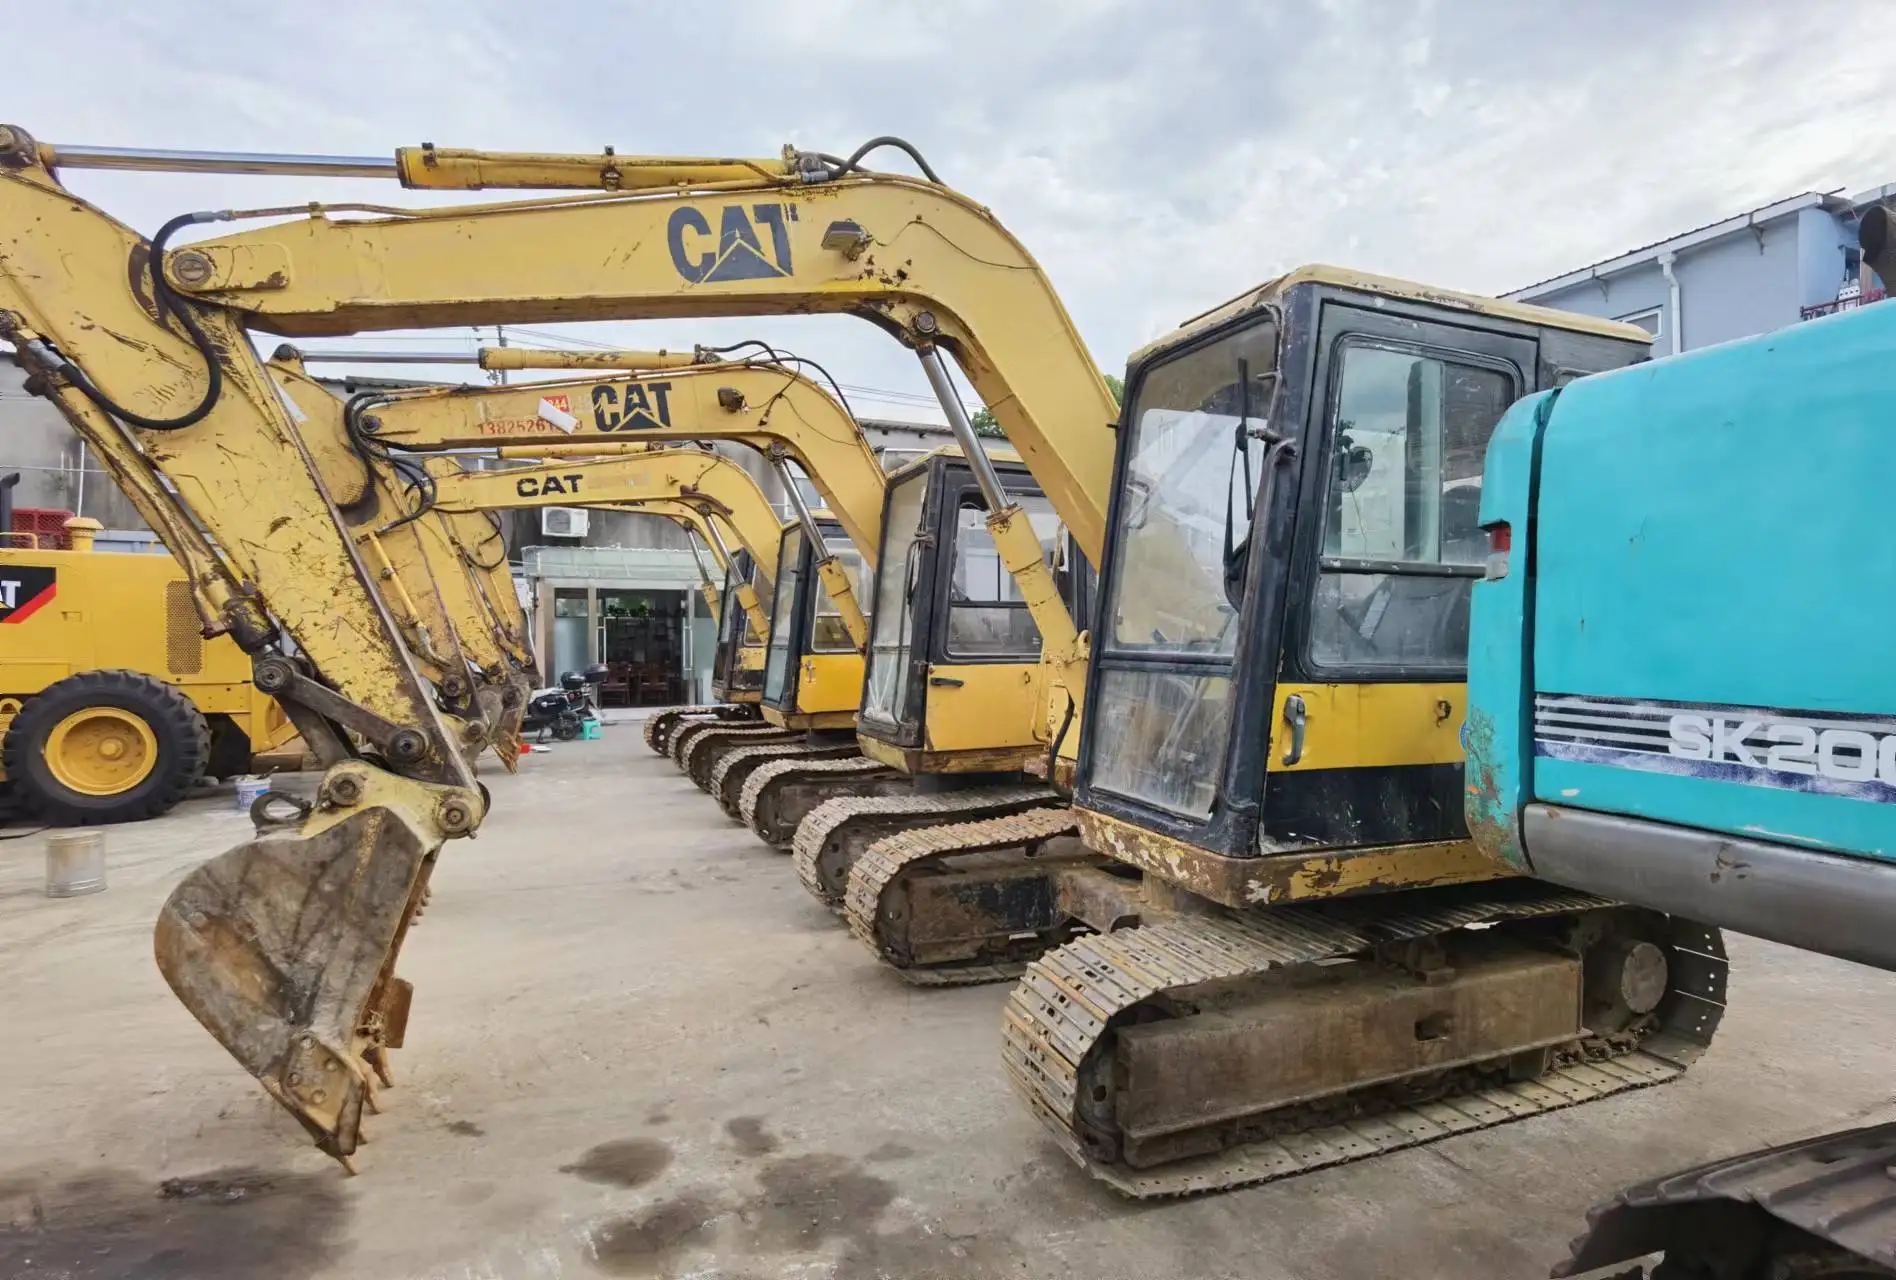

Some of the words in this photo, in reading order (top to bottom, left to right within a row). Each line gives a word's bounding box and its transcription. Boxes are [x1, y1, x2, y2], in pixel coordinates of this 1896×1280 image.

[667, 203, 798, 284] CAT
[591, 382, 671, 433] CAT
[516, 474, 583, 498] CAT
[0, 580, 22, 609] T
